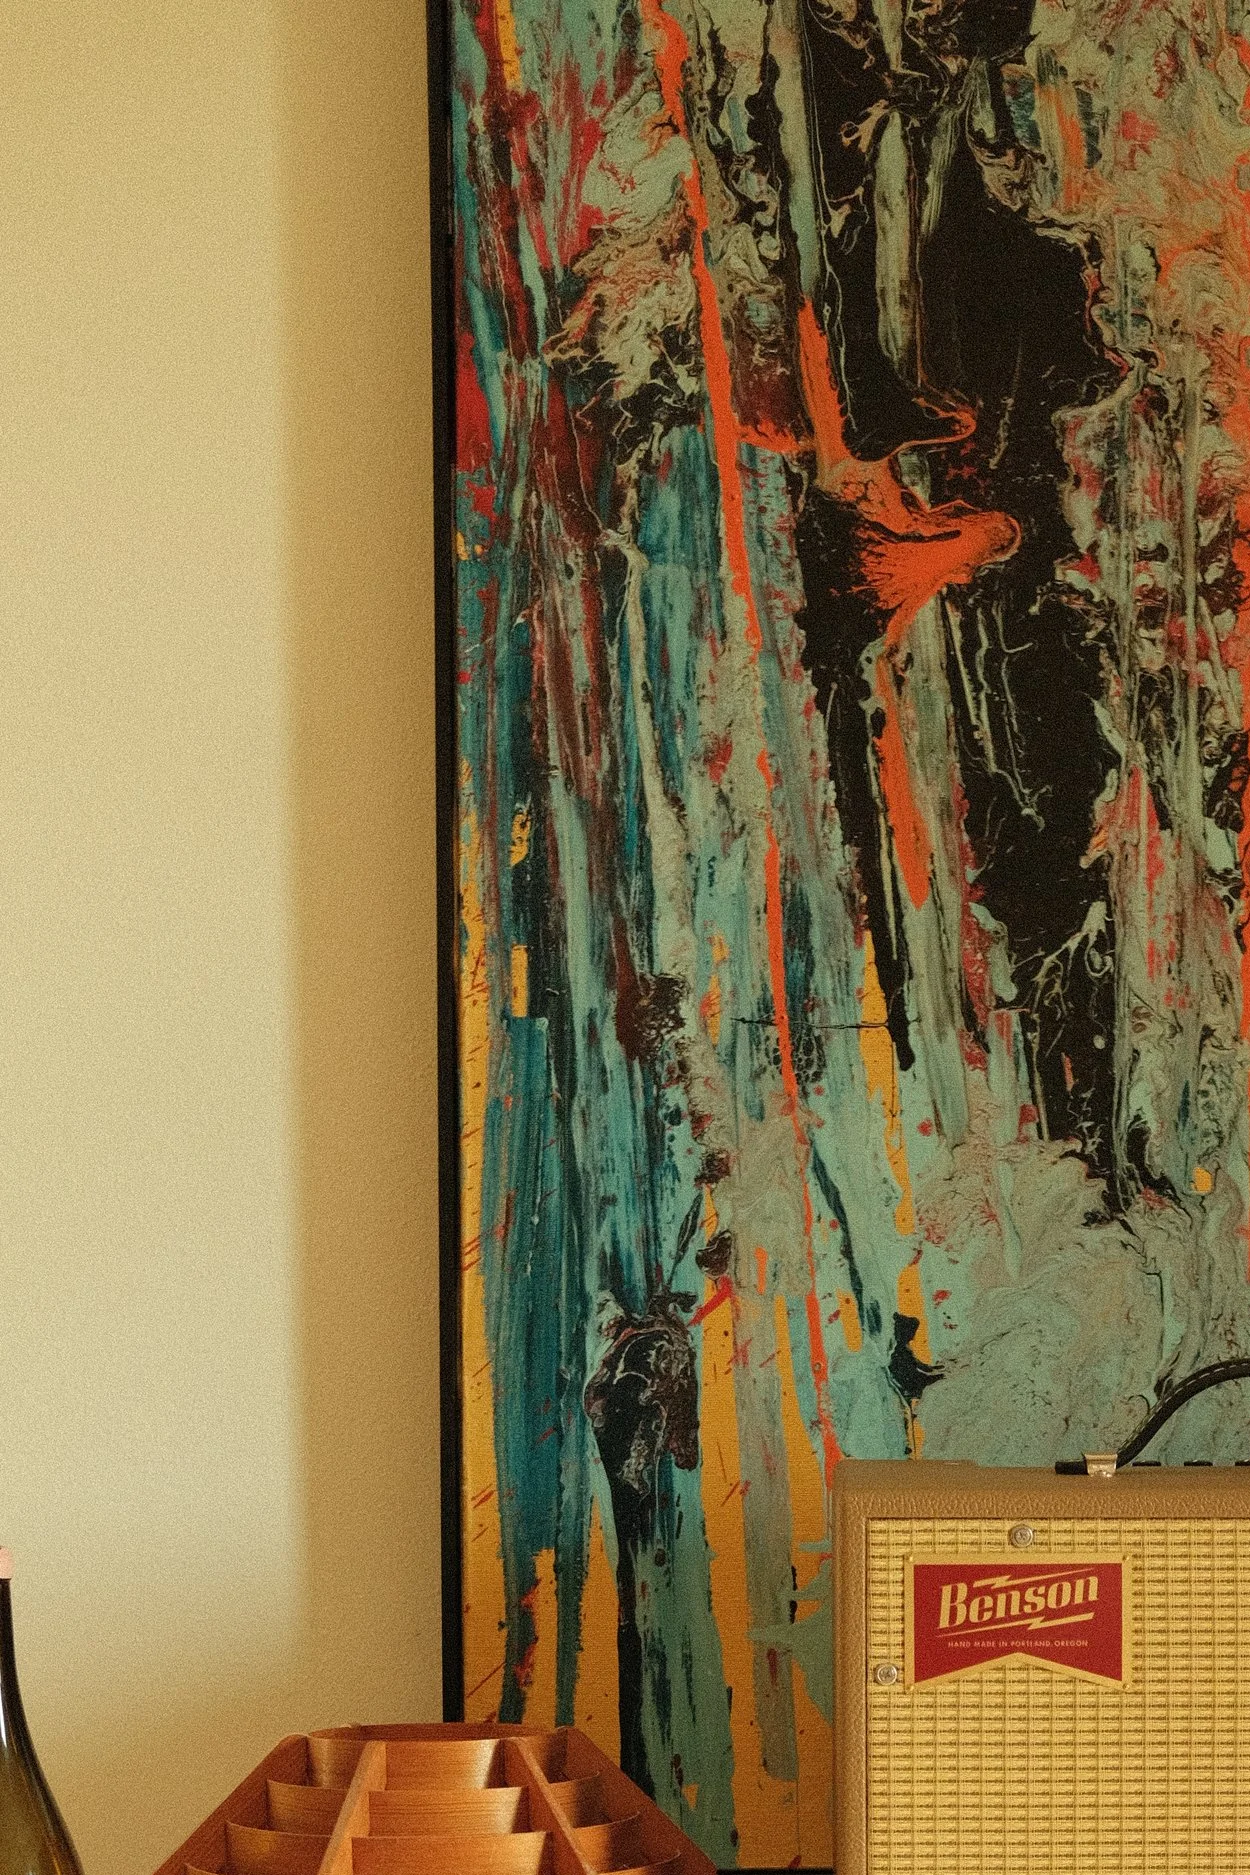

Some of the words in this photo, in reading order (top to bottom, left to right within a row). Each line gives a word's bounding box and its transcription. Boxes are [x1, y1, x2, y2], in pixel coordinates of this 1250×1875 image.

[938, 1575, 1100, 1630] Benson
[947, 1640, 971, 1648] HAND
[974, 1640, 996, 1648] MADE
[999, 1640, 1008, 1648] IN
[1010, 1639, 1051, 1648] PORTLAND
[1054, 1638, 1089, 1648] OREGON
